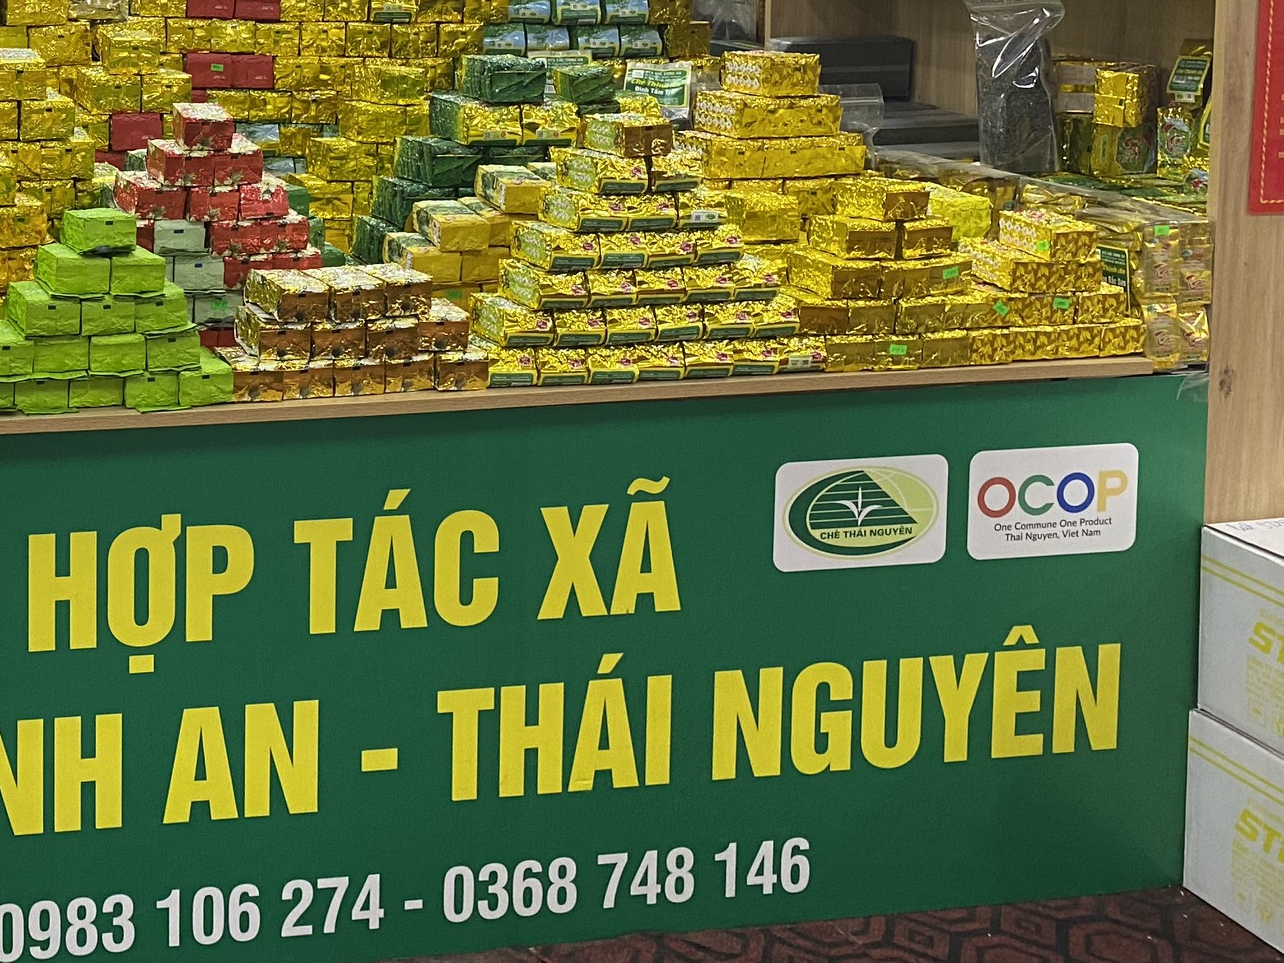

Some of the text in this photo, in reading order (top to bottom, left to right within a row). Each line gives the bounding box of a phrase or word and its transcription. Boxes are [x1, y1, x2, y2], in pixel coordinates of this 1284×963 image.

[976, 469, 1129, 519] OCOP
[820, 524, 913, 541] CHÈ THÁI NGUYÊN
[994, 516, 1112, 532] One Commune One Product
[1025, 528, 1101, 543] Nguyen, Viet Nam
[27, 476, 682, 674] HỢP TÁC XÃ
[162, 699, 319, 825] AN
[359, 747, 399, 773] -
[436, 652, 674, 802] THÁI
[711, 624, 1122, 782] NGUYÊN
[156, 881, 262, 950] 106
[281, 872, 385, 939] 274
[442, 858, 579, 925] 0368
[597, 846, 697, 910] 748
[714, 837, 812, 899] 146
